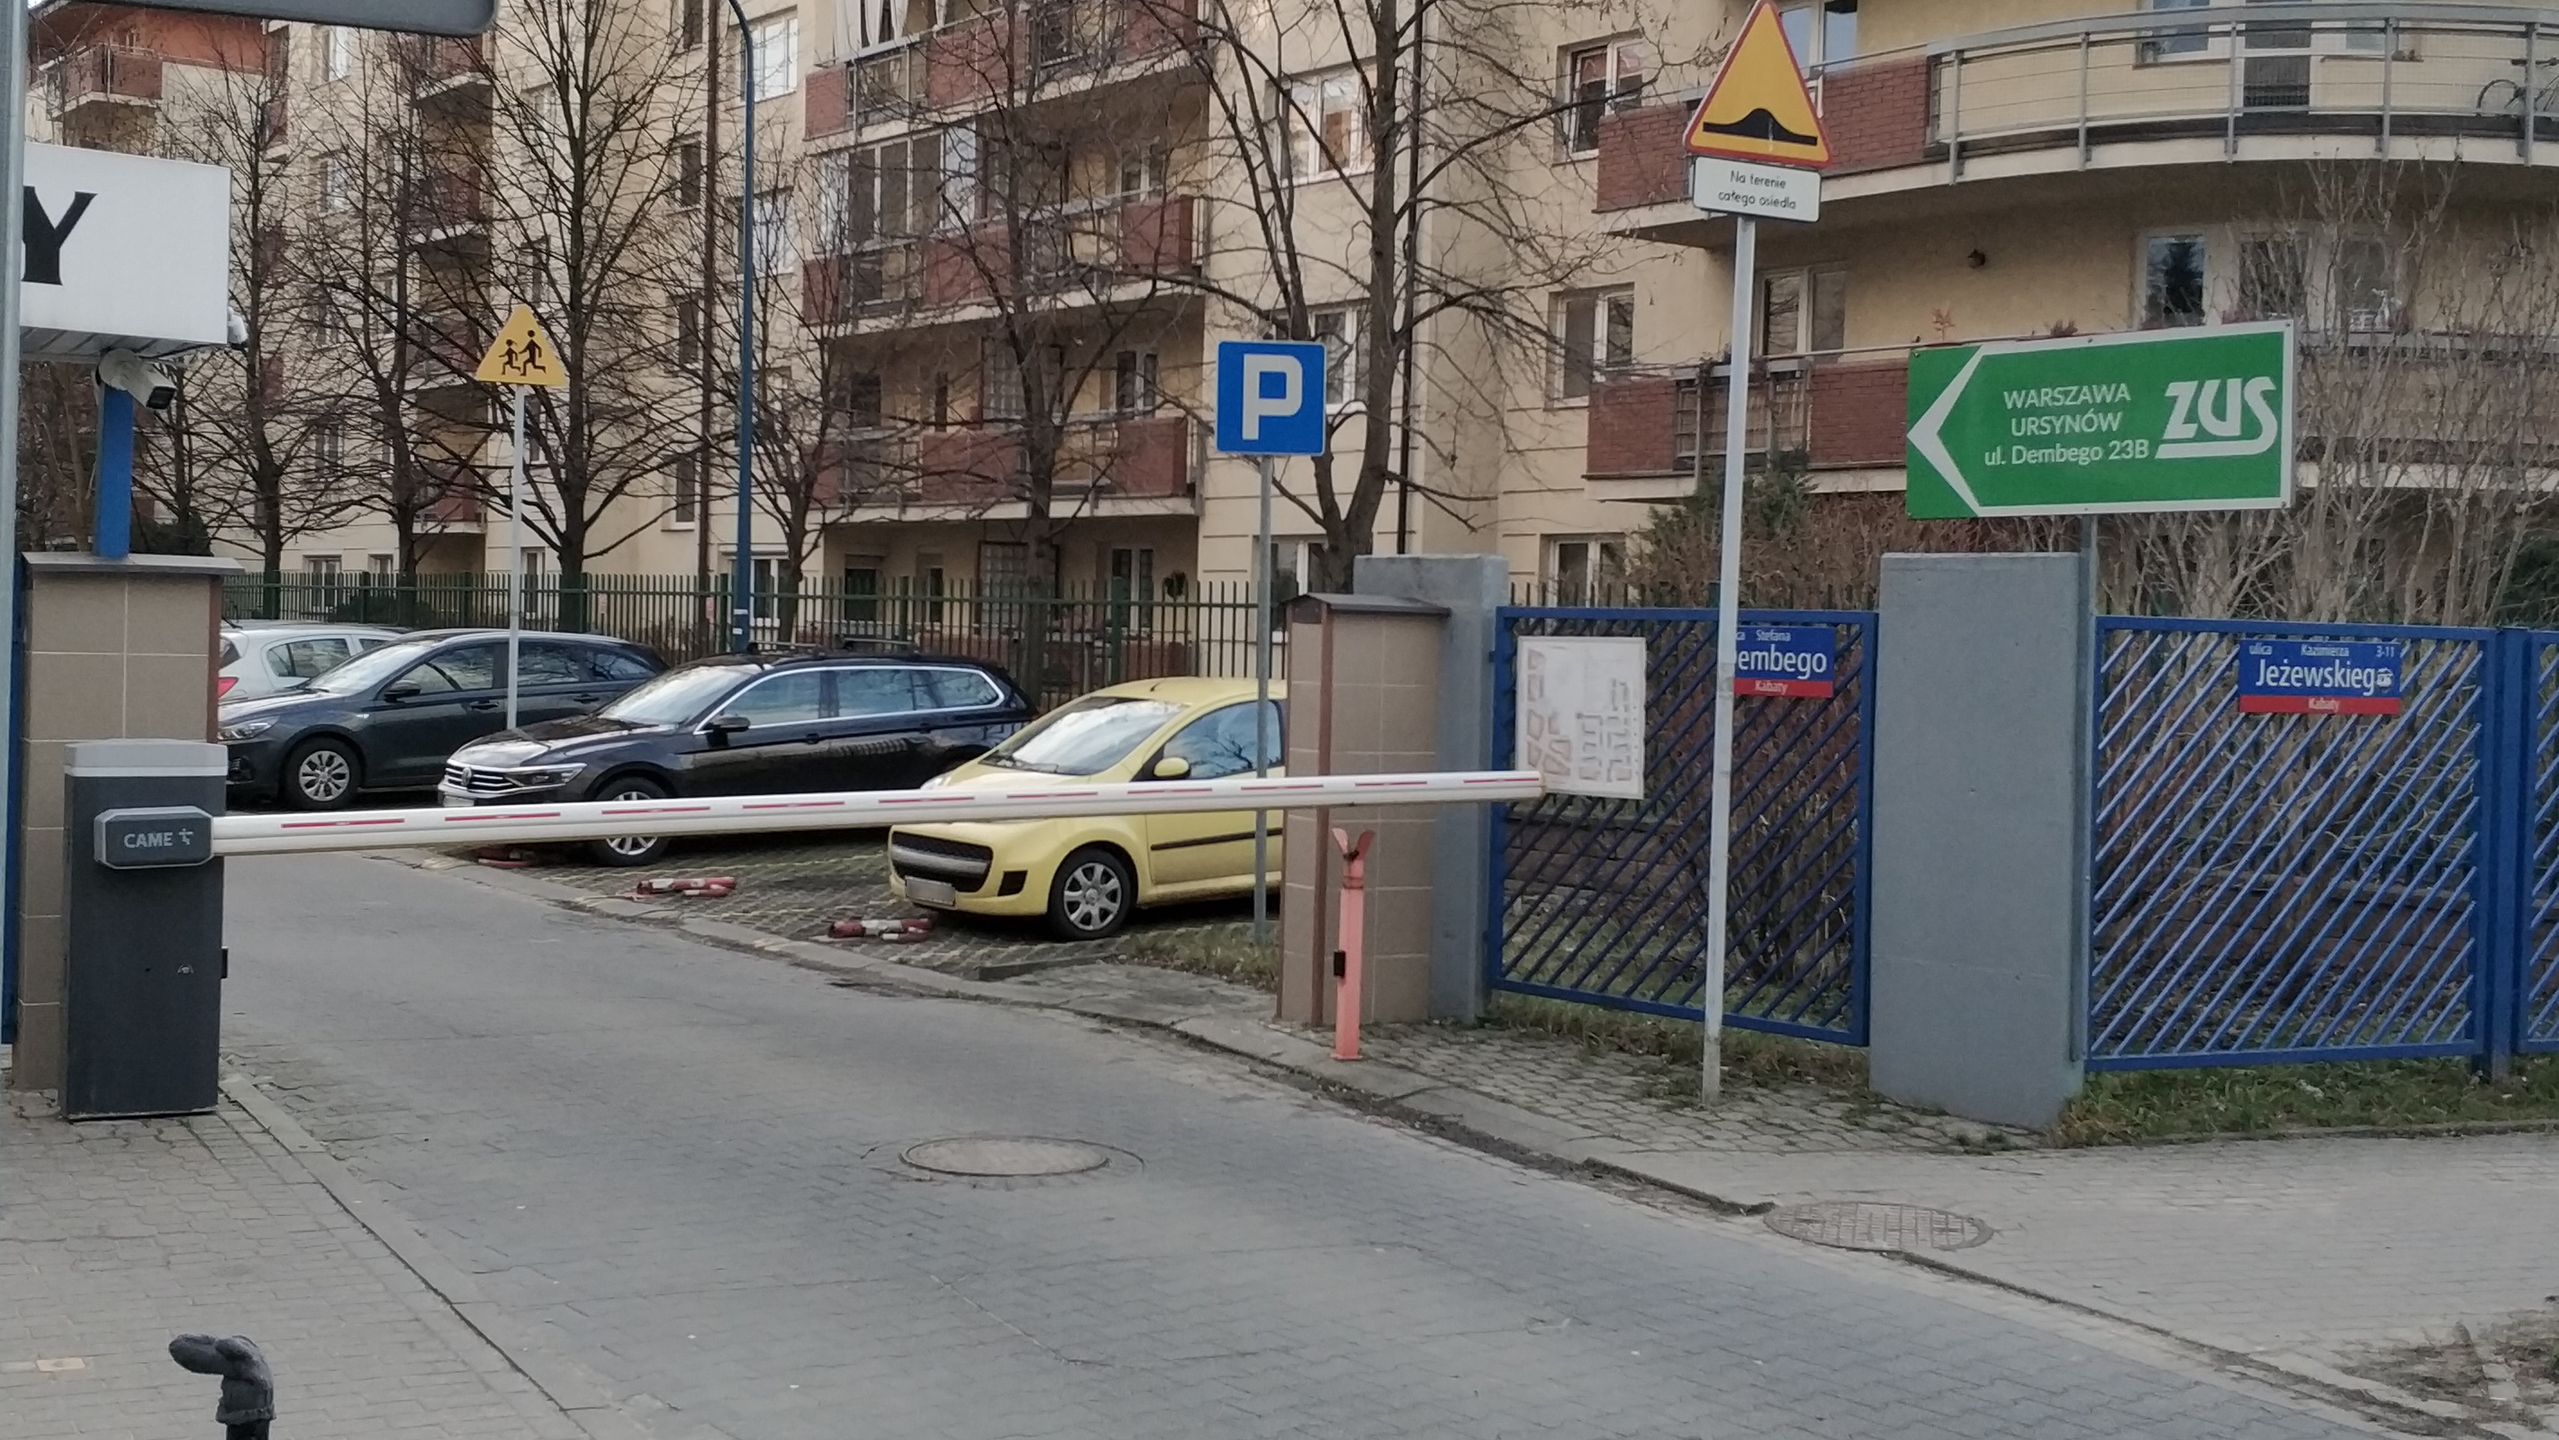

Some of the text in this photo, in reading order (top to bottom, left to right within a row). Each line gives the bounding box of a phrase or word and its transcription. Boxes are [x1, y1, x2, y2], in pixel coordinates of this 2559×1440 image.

[1729, 170, 1787, 189] Na terenie
[1718, 190, 1797, 210] całego osiedla
[22, 185, 98, 286] Y
[1241, 353, 1303, 440] P
[2003, 382, 2131, 410] WARSZAWA
[2010, 408, 2123, 437] URSYNÓW
[2155, 376, 2279, 459] ZUS
[1984, 439, 2150, 466] ul. Dembego 23B
[1737, 643, 1829, 680] embego
[2249, 642, 2273, 656] ulica
[2376, 645, 2395, 658] 3-11
[124, 832, 174, 848] CAME
